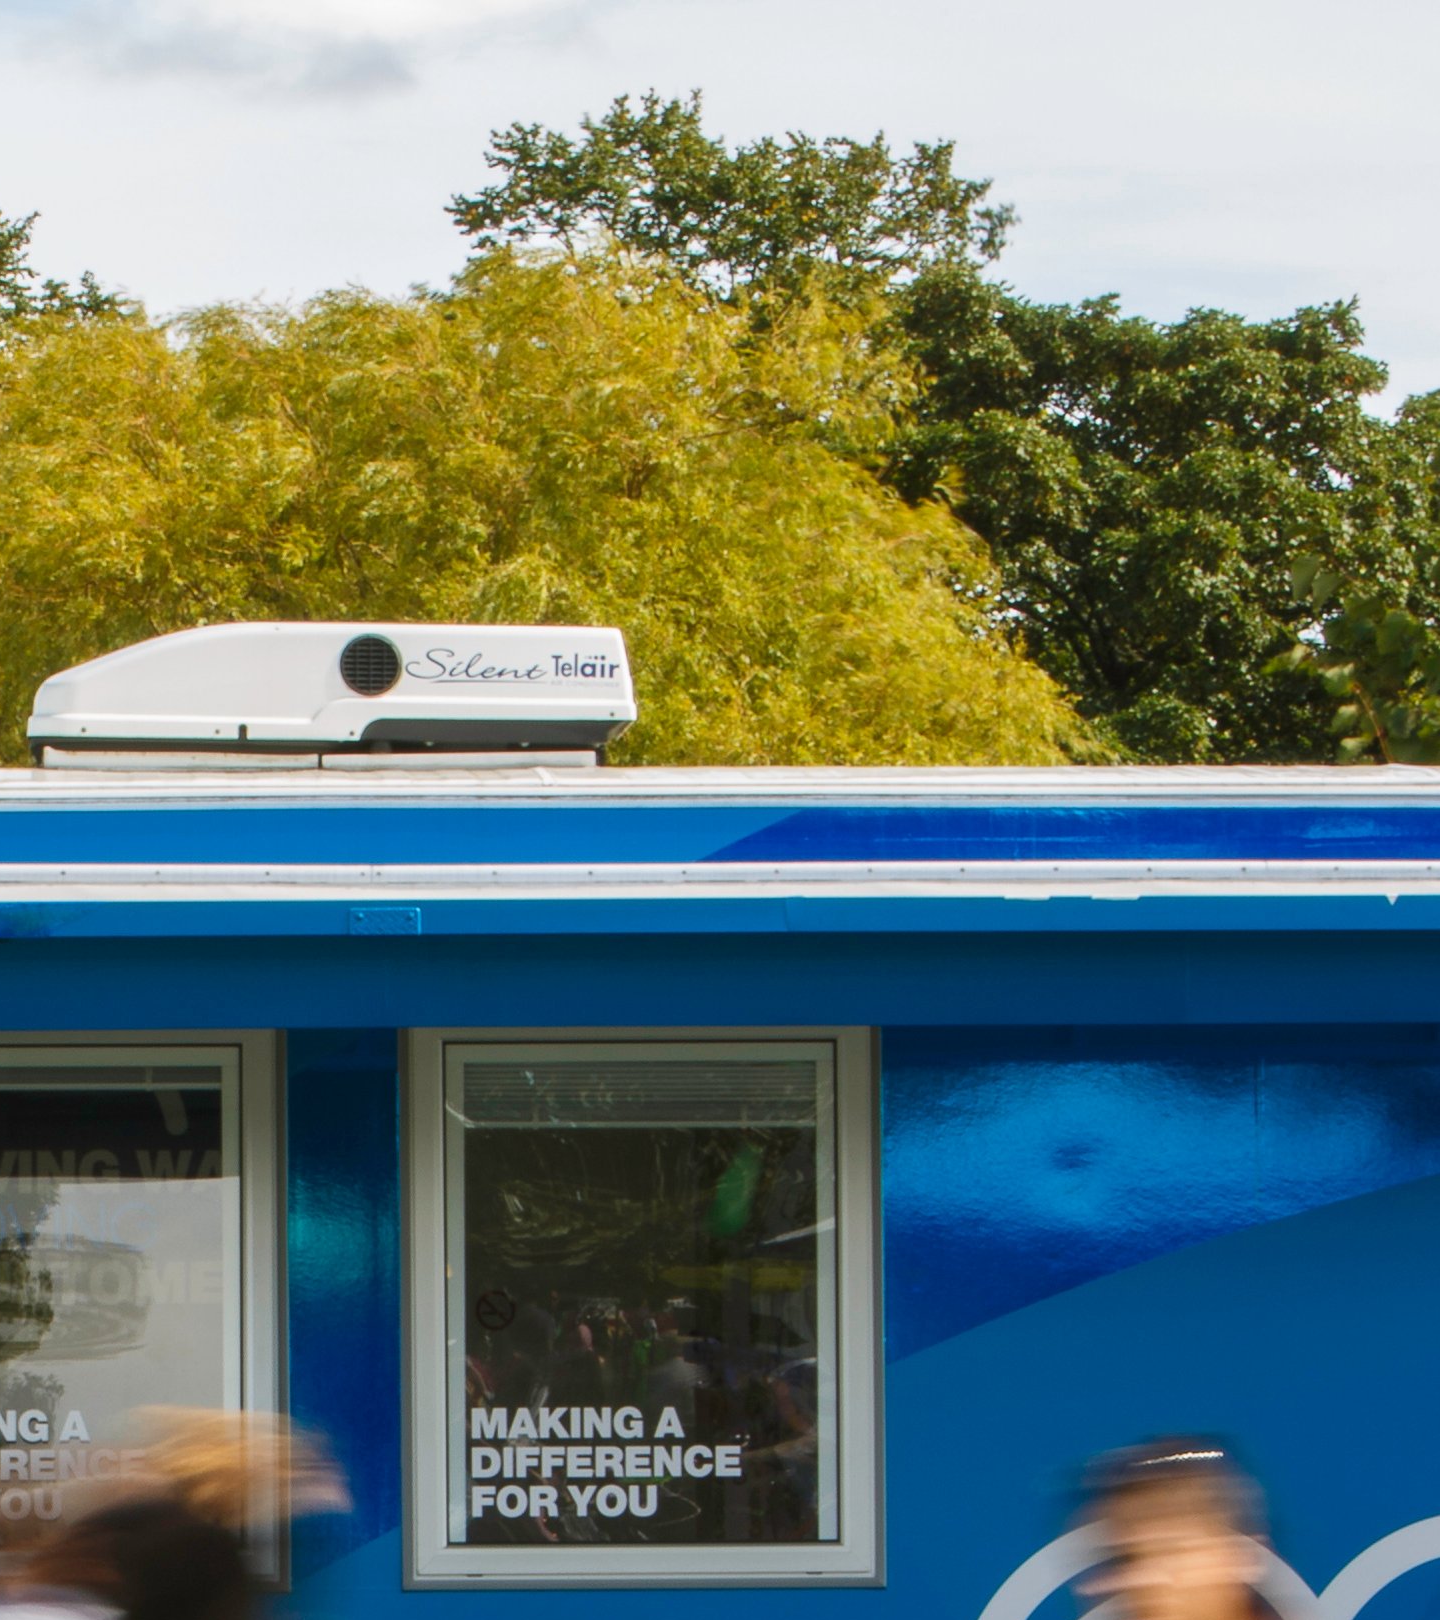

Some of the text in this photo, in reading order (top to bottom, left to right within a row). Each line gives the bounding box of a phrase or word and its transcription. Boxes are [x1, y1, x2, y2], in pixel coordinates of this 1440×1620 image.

[405, 648, 547, 680] Silent
[59, 1410, 91, 1442] A
[471, 1407, 685, 1439] MAKING A
[471, 1445, 742, 1478] DIFFERENCE
[471, 1485, 658, 1518] FOR YOU
